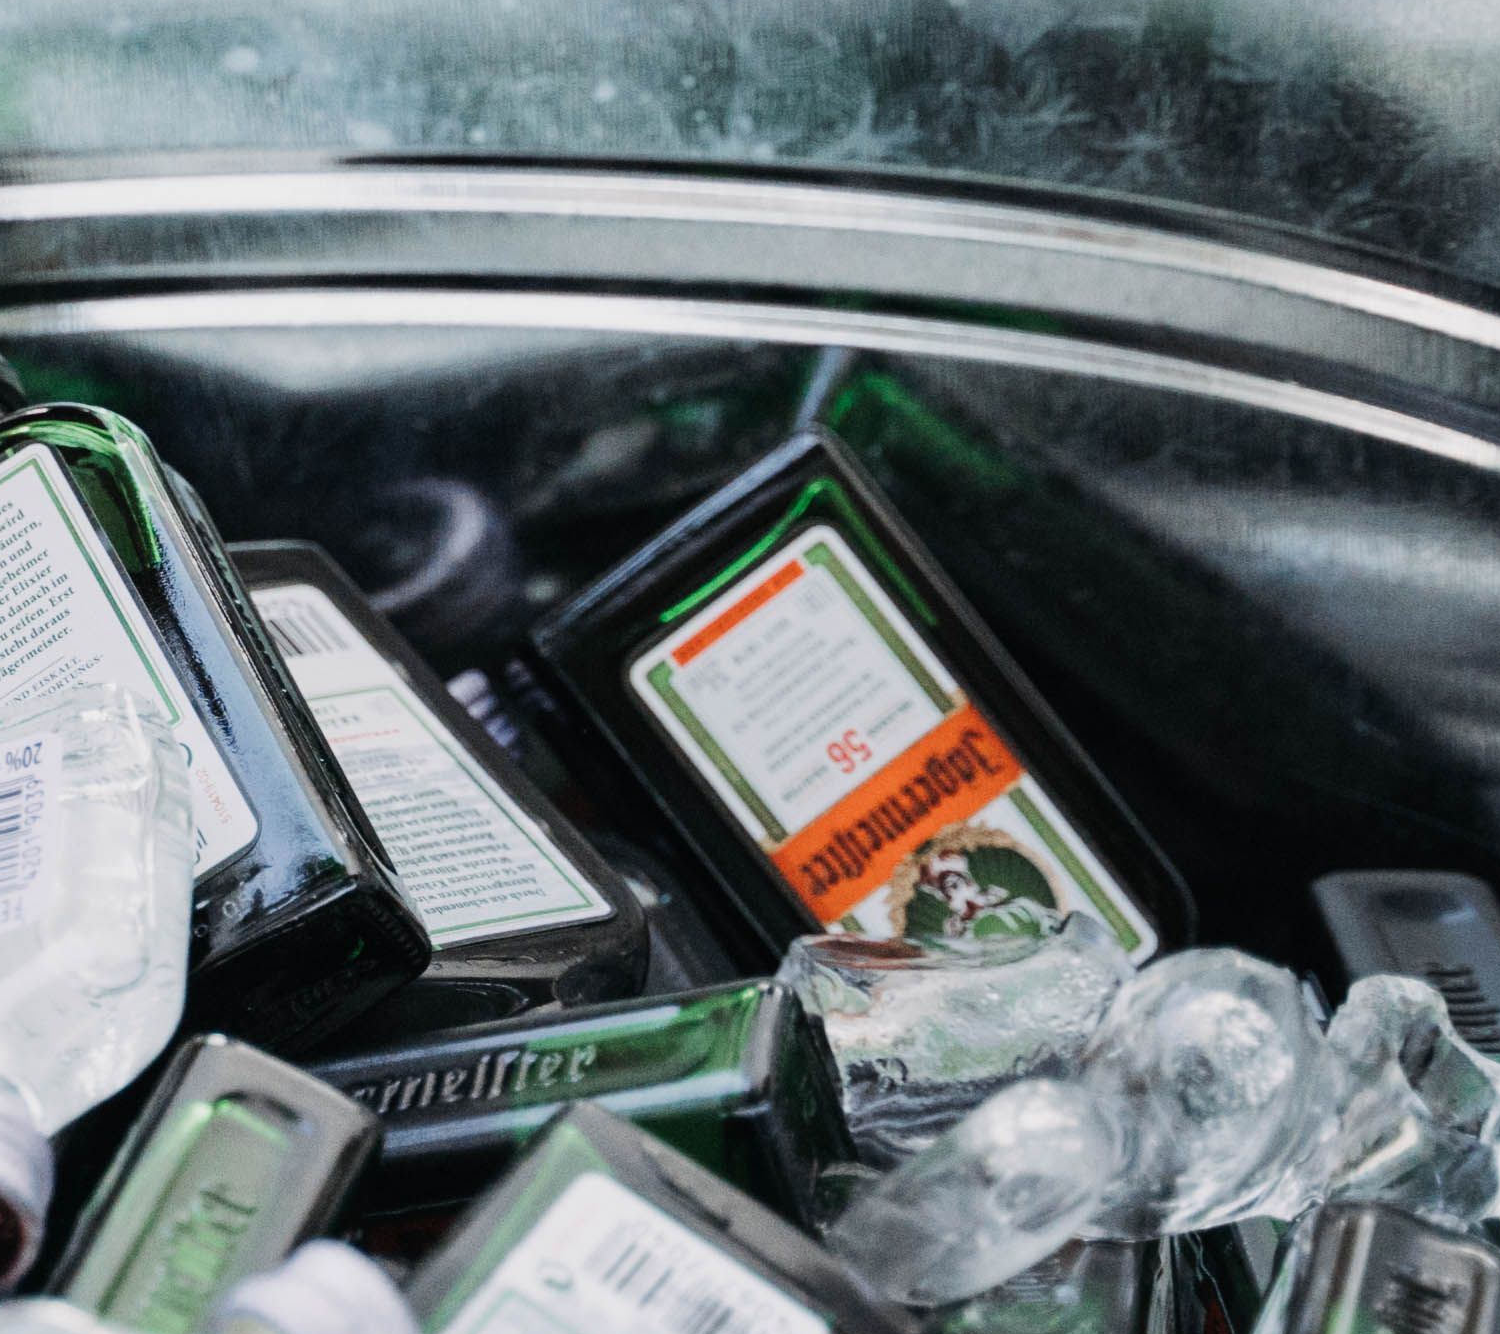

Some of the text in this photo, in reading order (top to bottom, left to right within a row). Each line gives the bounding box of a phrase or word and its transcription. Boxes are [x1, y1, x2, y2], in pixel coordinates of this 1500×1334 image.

[6, 539, 33, 562] und
[4, 582, 51, 618] danach
[49, 570, 69, 587] im
[10, 562, 53, 596] Elixier
[6, 602, 48, 635] reifen.
[47, 584, 75, 607] Erst
[26, 604, 71, 639] daraus
[826, 727, 871, 778] 56
